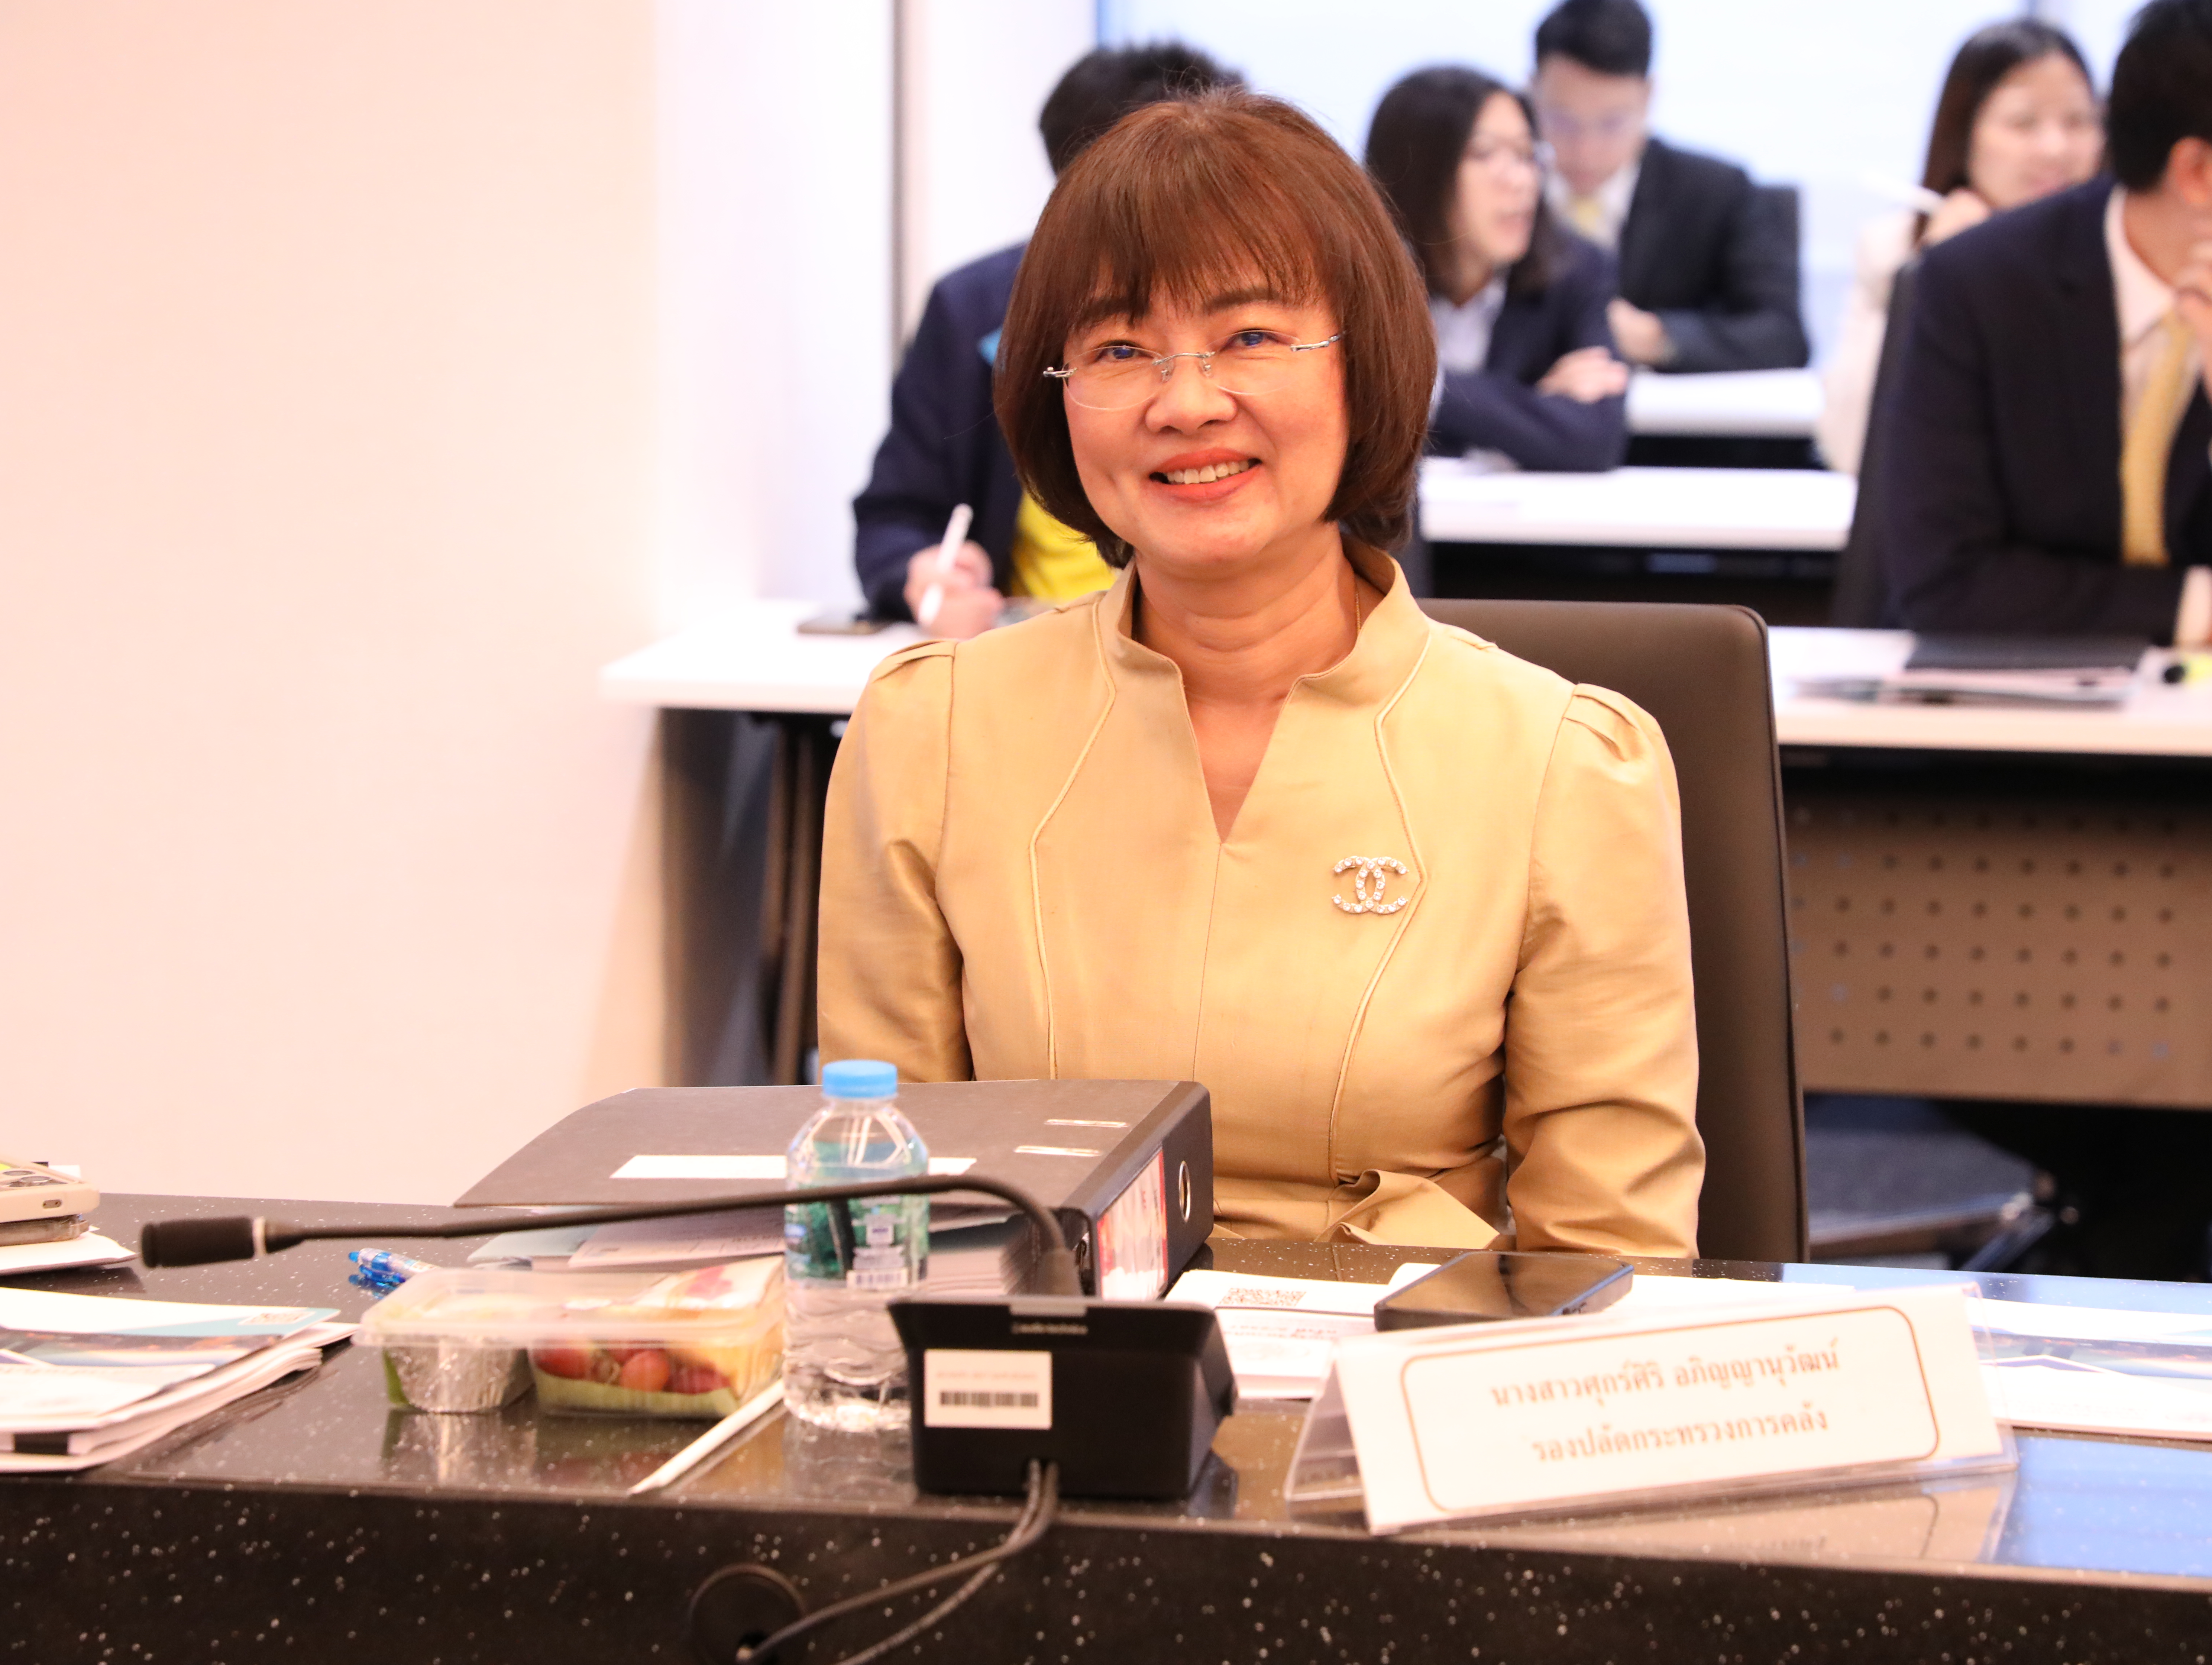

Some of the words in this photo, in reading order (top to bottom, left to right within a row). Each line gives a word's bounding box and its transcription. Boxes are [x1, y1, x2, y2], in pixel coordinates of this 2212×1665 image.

[1674, 1337, 1840, 1388] อภิญญานุวัฒน์
[1532, 1401, 1828, 1462] รองปลัดกระทรวงการคลัง
